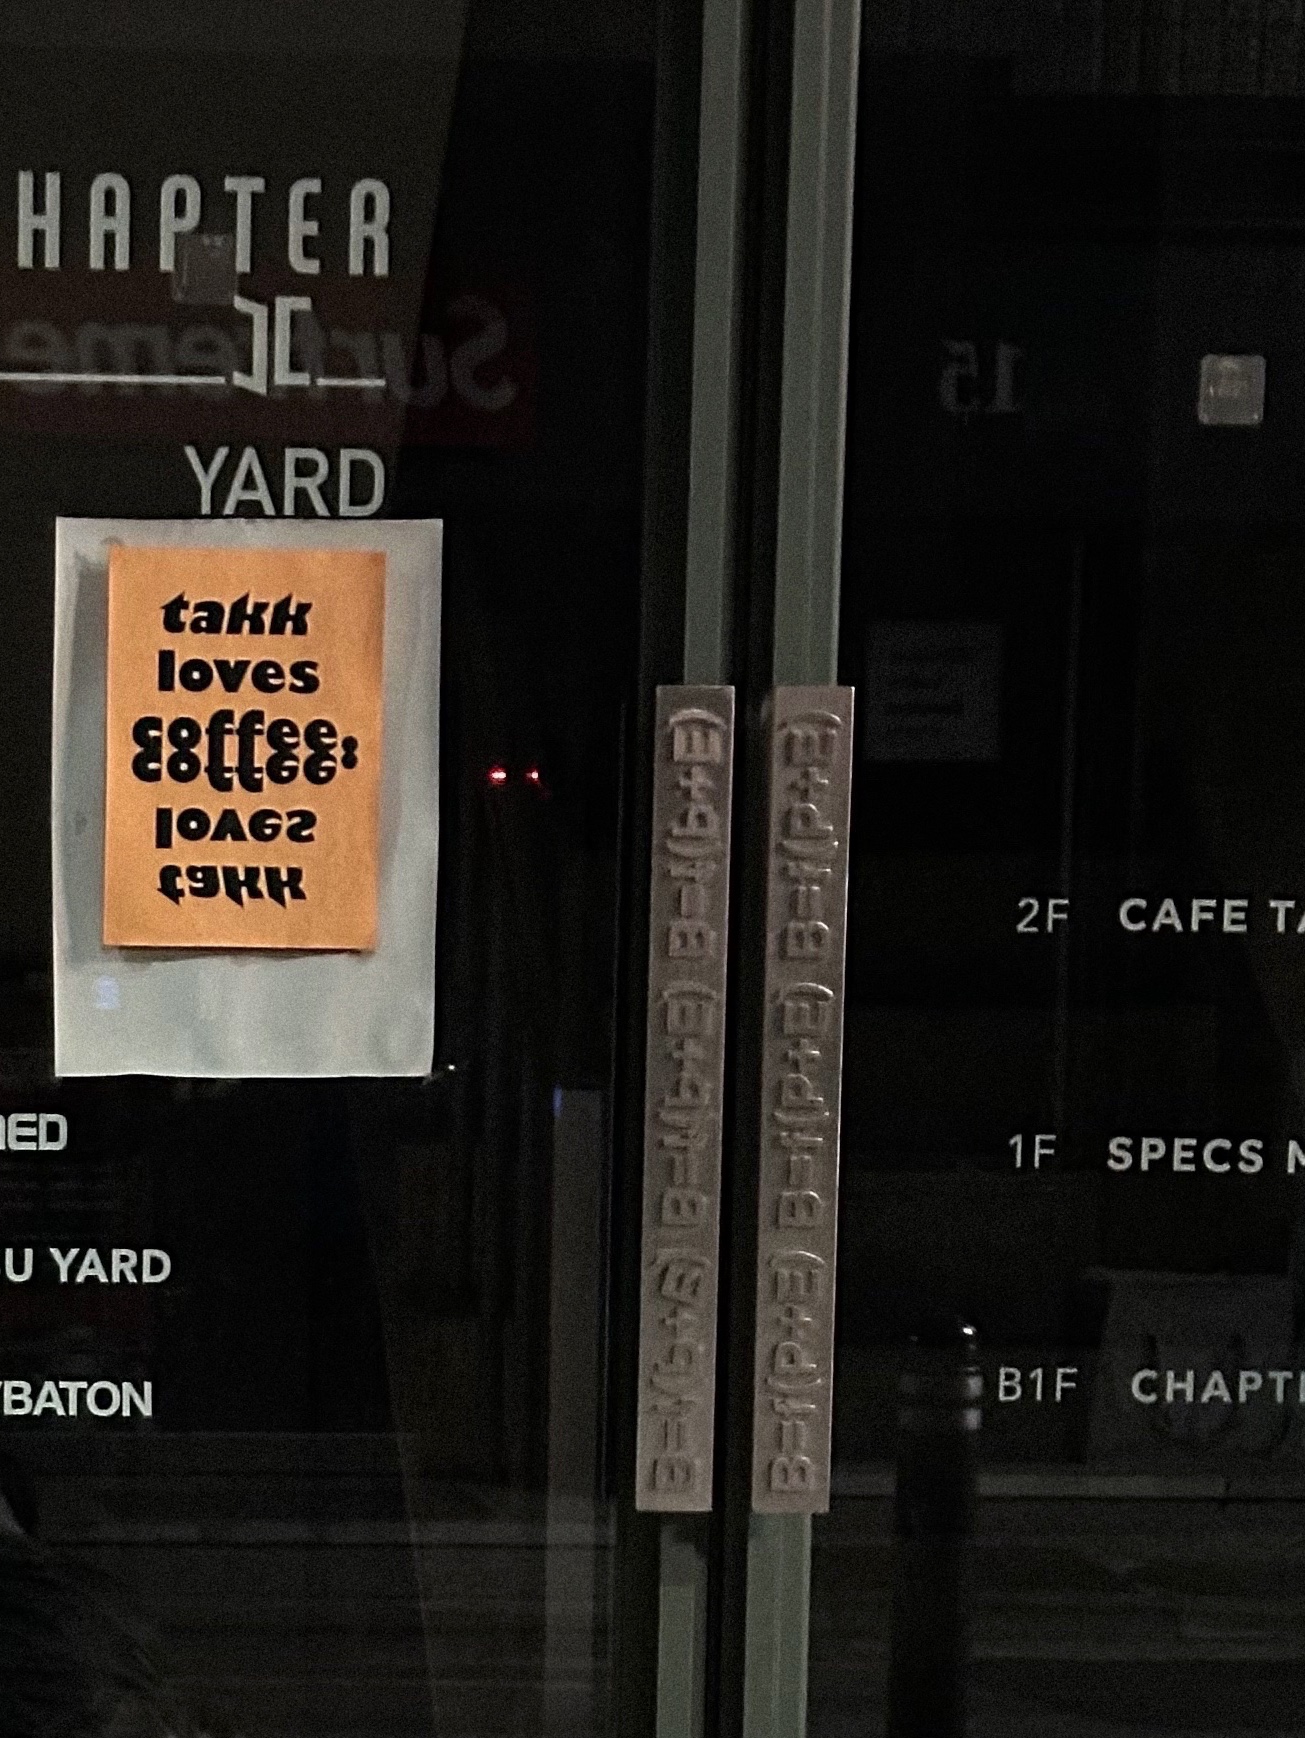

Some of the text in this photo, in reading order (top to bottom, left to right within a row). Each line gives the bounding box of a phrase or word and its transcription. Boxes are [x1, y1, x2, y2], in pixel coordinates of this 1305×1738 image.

[184, 446, 387, 517] YARD
[160, 592, 313, 636] takk
[157, 649, 320, 694] loves
[1016, 897, 1305, 934] 2F CAFE T
[1008, 1134, 1057, 1169] 1F
[1107, 1136, 1264, 1174] SPECS
[48, 1247, 172, 1284] YARD
[998, 1366, 1305, 1403] B1F CHAPT
